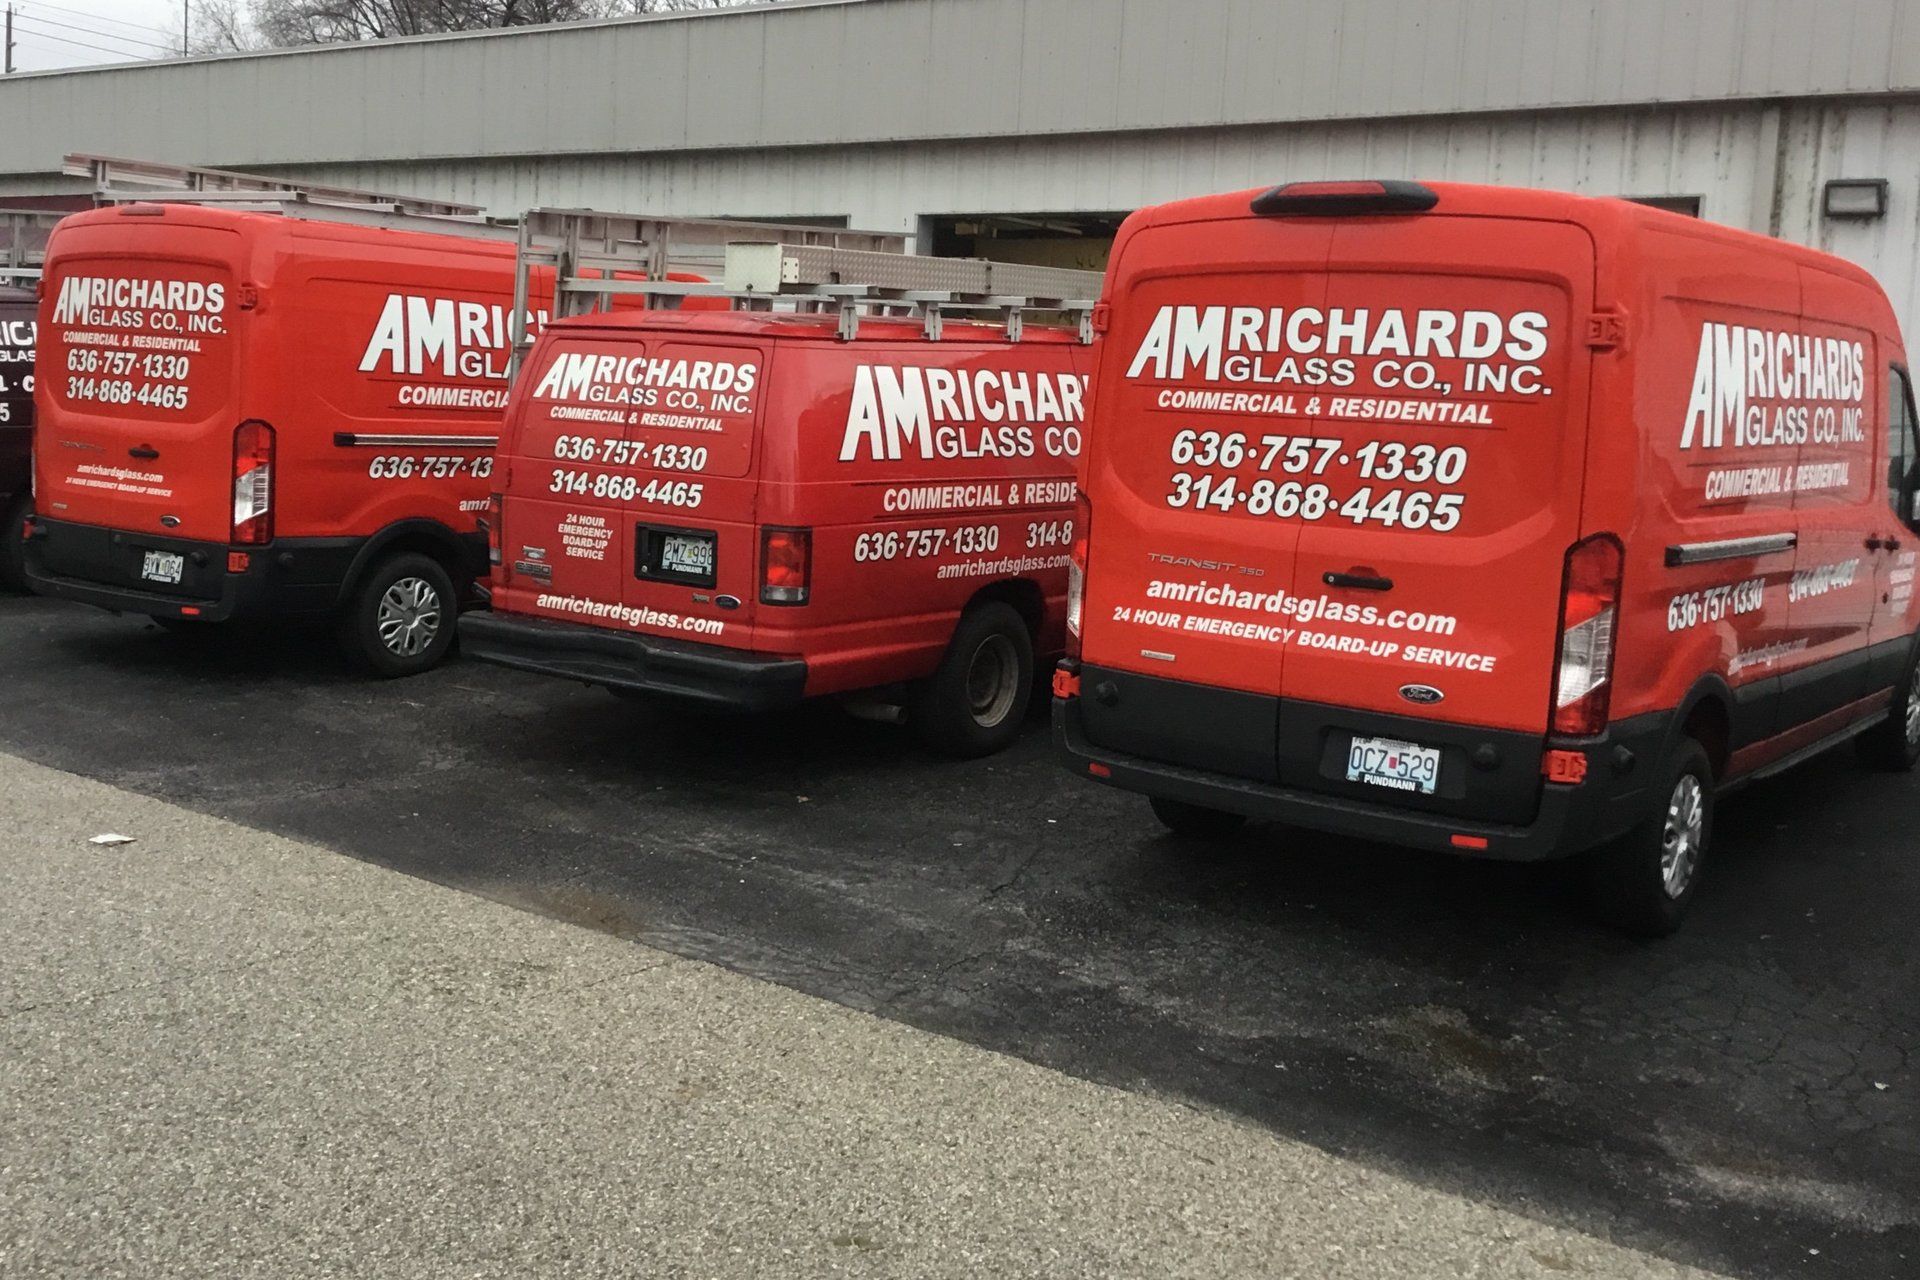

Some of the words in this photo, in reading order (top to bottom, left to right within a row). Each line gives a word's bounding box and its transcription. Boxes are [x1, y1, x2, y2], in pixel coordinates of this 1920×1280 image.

[89, 309, 143, 328] GLASS
[188, 315, 227, 334] INC.
[63, 331, 119, 346] COMMERCIAL
[122, 335, 129, 347] &
[132, 335, 201, 352] RESIDENTIAL
[1224, 355, 1356, 387] GLASS
[1464, 363, 1553, 396] INC.
[589, 385, 657, 406] GLASS
[710, 394, 752, 414] INC.
[1157, 389, 1298, 415] COMMERCIAL
[1304, 398, 1322, 416] &
[1329, 398, 1493, 425] RESIDENTIAL
[550, 406, 625, 423] COMMERCIAL
[629, 413, 638, 424] &
[641, 413, 723, 432] RESIDENTIAL
[1745, 405, 1808, 446] GLASS
[1841, 407, 1865, 442] INC.
[935, 426, 1034, 458] GLASS
[77, 464, 164, 483] amrichardsglass.com
[1705, 466, 1781, 500] COMMERCIAL
[884, 484, 1002, 512] COMMERCIAL
[1008, 483, 1020, 505] &
[558, 523, 613, 540] EMERGENCY
[566, 513, 578, 525] 24
[579, 515, 605, 527] HOUR
[562, 535, 608, 549] BOARD-UP
[566, 546, 604, 561] SERVICE
[937, 553, 1071, 579] amrichardsglass.com
[1147, 552, 1236, 571] TRANSIT
[1239, 566, 1265, 576] 350
[536, 593, 725, 636] amrichardsglass.com
[1146, 577, 1457, 636] amrichardsglass.com
[1112, 606, 1132, 622] 24
[1133, 609, 1181, 629] HOUR
[1183, 615, 1296, 643] EMERGENCY
[1297, 630, 1399, 658] BOARD-UP
[1402, 644, 1497, 673] SERVICE
[1363, 774, 1416, 791] PUNDMANN
